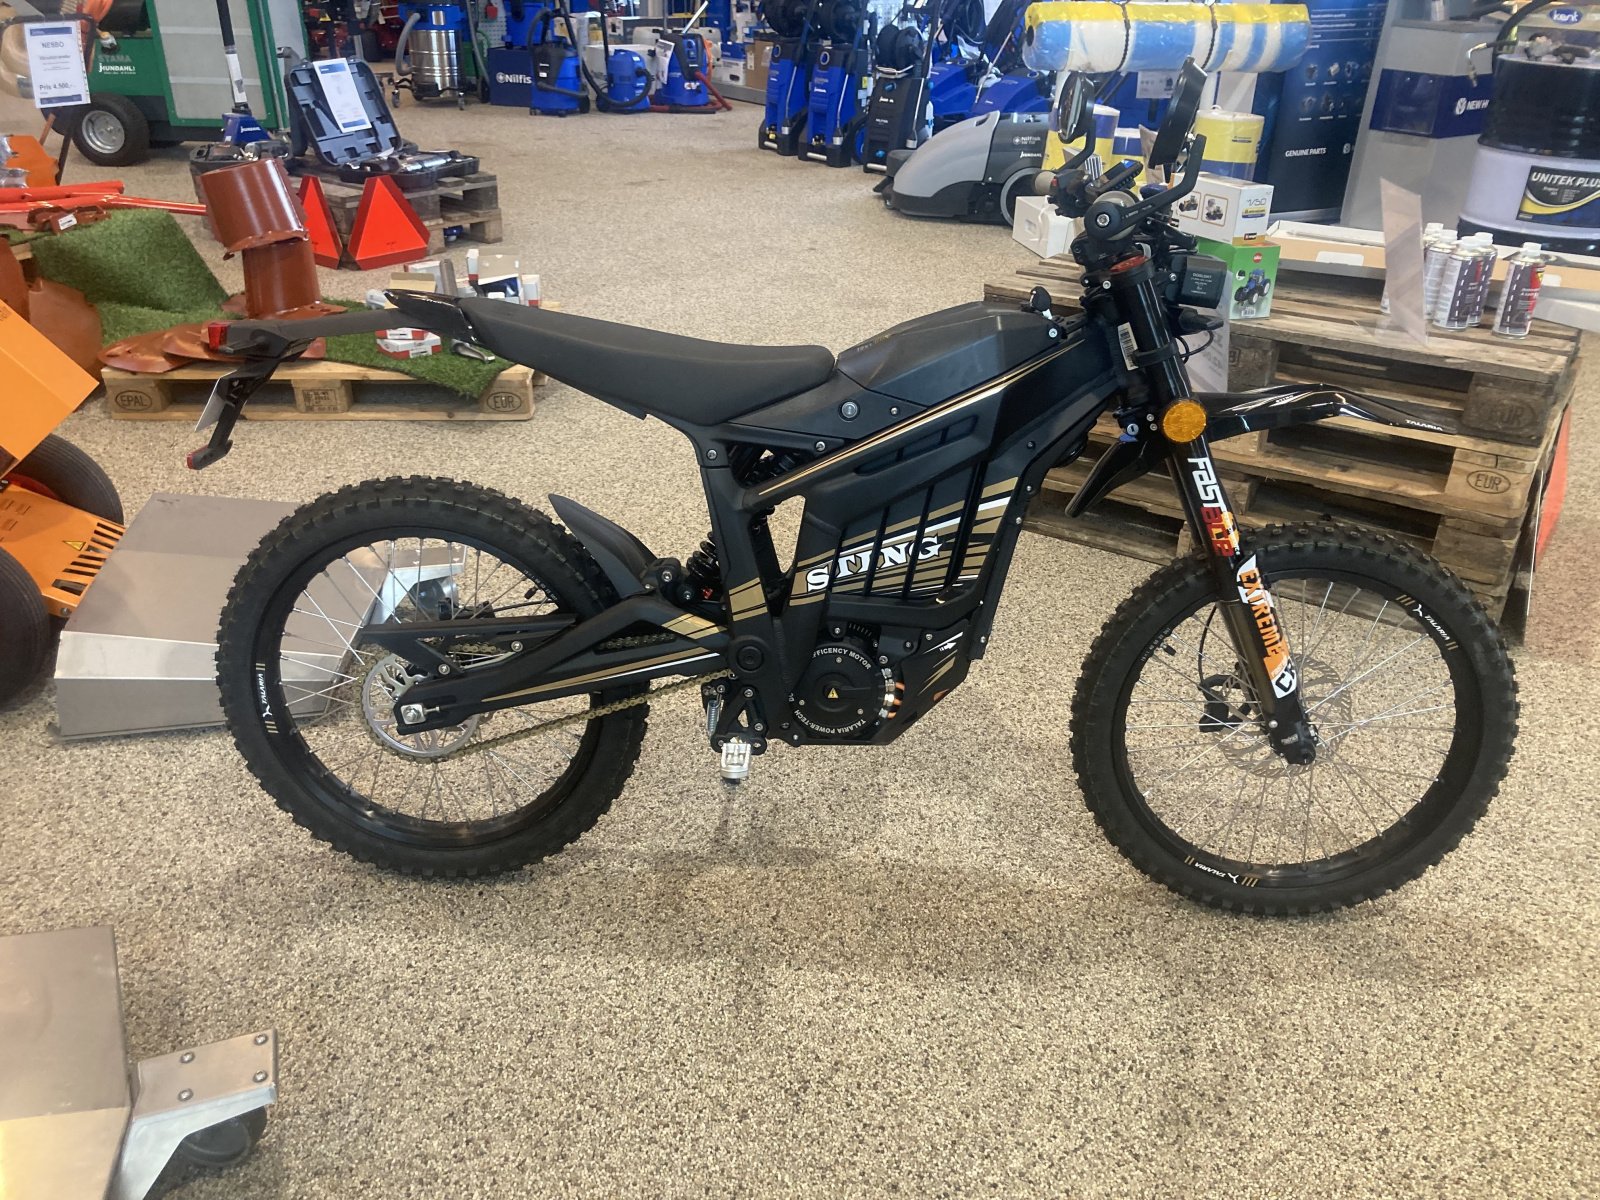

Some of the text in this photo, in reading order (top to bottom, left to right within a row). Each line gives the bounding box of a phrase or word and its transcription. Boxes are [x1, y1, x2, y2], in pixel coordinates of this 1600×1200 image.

[1553, 10, 1579, 22] kent
[505, 73, 533, 84] Nilfis
[1285, 147, 1327, 157] GENUINE PARTS
[1531, 171, 1576, 186] UNITEK
[120, 394, 148, 407] EPAL
[493, 395, 515, 408] EUR
[1405, 419, 1443, 431] TALARIA
[1474, 473, 1502, 492] EUR
[806, 535, 943, 592] STING
[1239, 568, 1284, 658] EXTREME
[1424, 614, 1451, 641] TALARIA
[848, 650, 872, 670] MOTOR
[258, 673, 268, 705] TALARIA
[794, 709, 866, 734] TALARIA POWER-TECH
[1194, 862, 1226, 878] TALARIA
